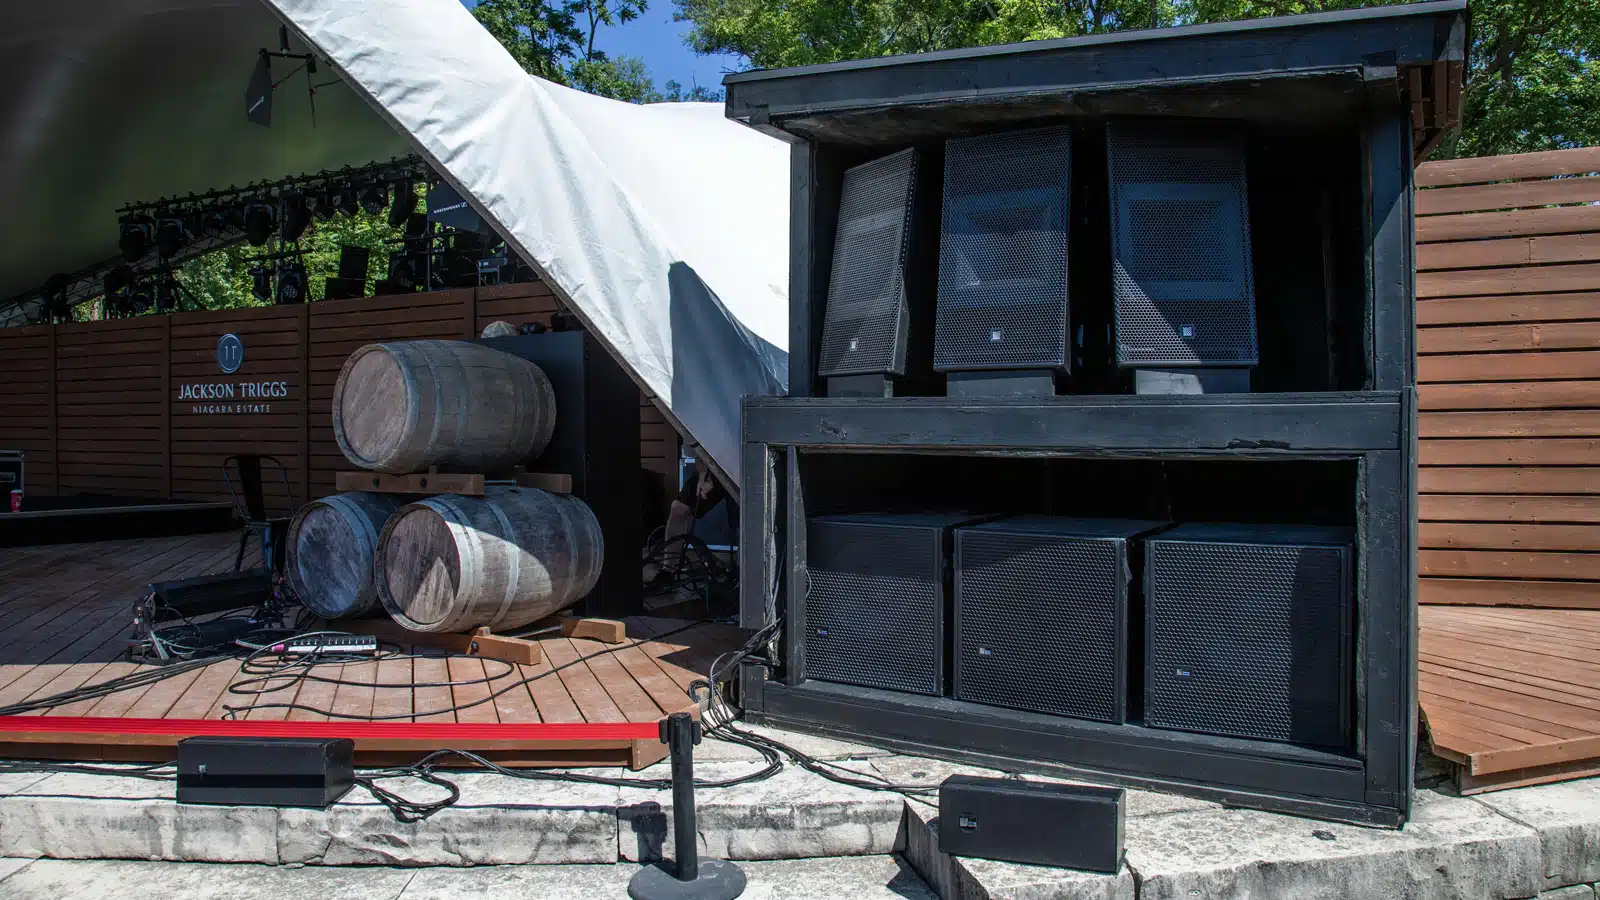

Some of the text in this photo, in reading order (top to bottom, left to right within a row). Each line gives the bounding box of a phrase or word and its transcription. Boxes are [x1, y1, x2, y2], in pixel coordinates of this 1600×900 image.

[178, 381, 288, 400] JACKSON TRIGGS
[192, 404, 271, 414] NIAGARA ESTATE
